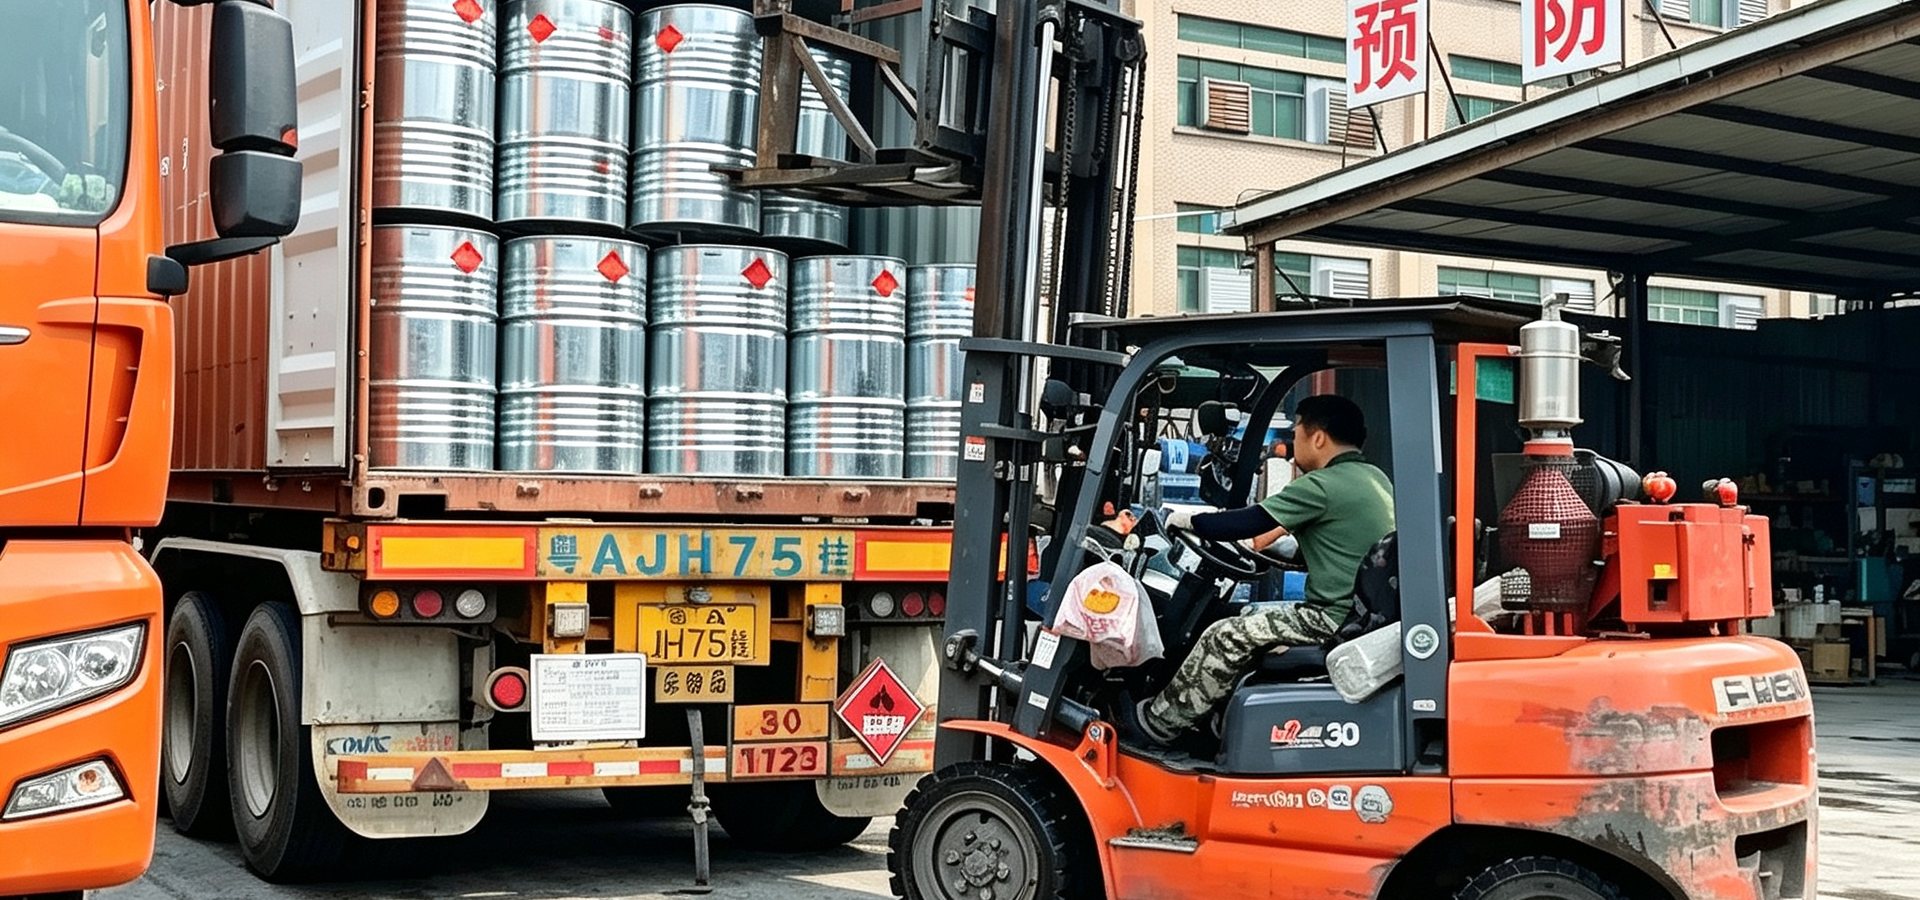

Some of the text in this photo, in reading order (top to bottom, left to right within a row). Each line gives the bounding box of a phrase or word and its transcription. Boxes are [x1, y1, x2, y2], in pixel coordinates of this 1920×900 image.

[1354, 0, 1418, 94] 预
[1534, 0, 1607, 67] 防
[760, 708, 802, 736] 30
[1324, 722, 1360, 748] 30
